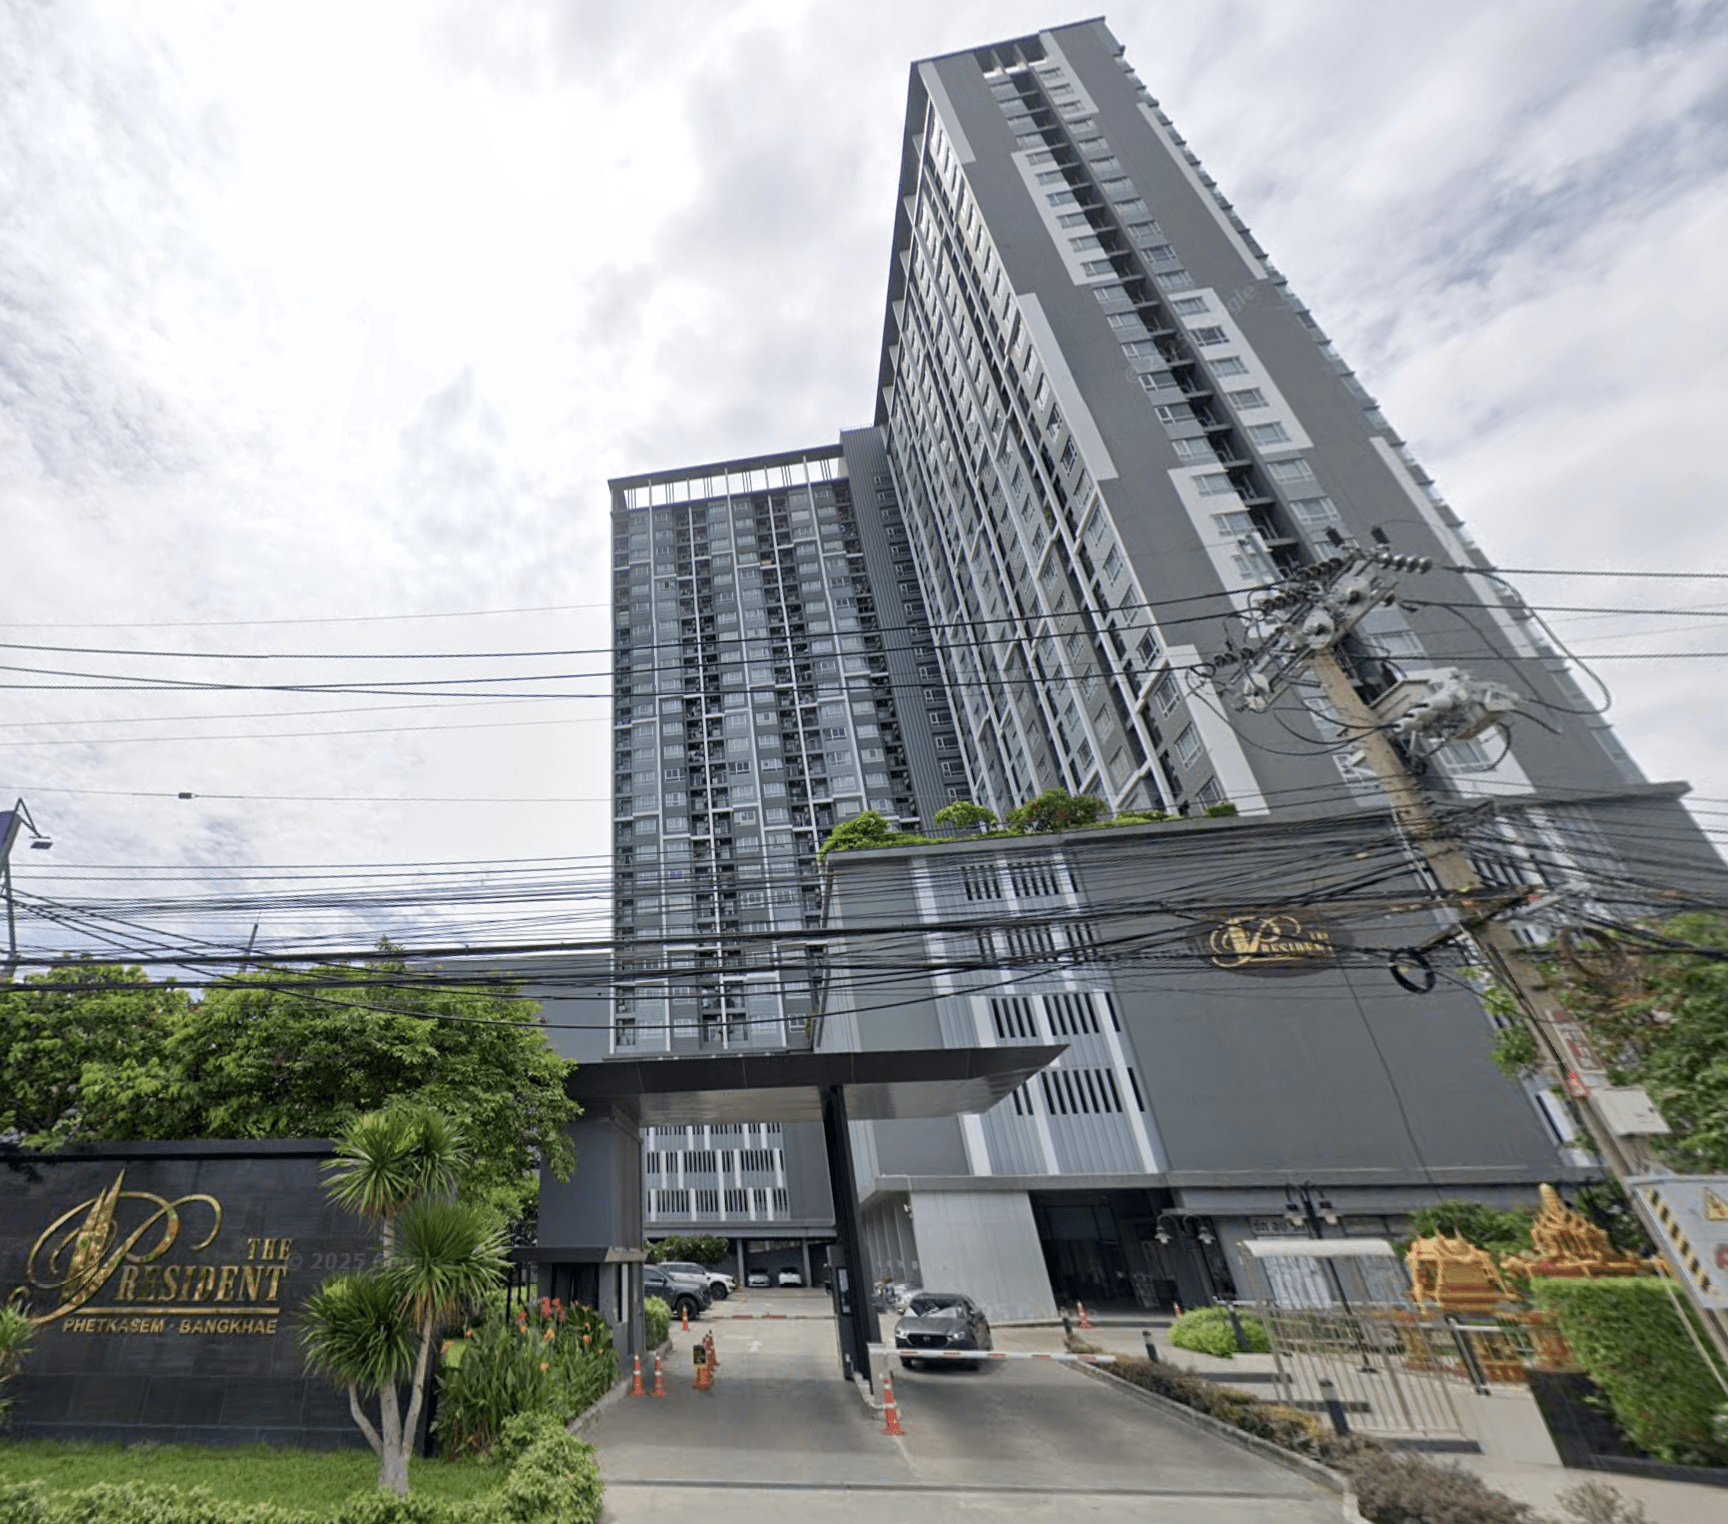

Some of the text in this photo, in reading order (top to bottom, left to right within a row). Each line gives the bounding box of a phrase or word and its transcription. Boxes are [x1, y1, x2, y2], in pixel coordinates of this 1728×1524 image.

[248, 1238, 292, 1261] THE
[62, 1317, 279, 1336] PHETKASEM BANGKHAE
